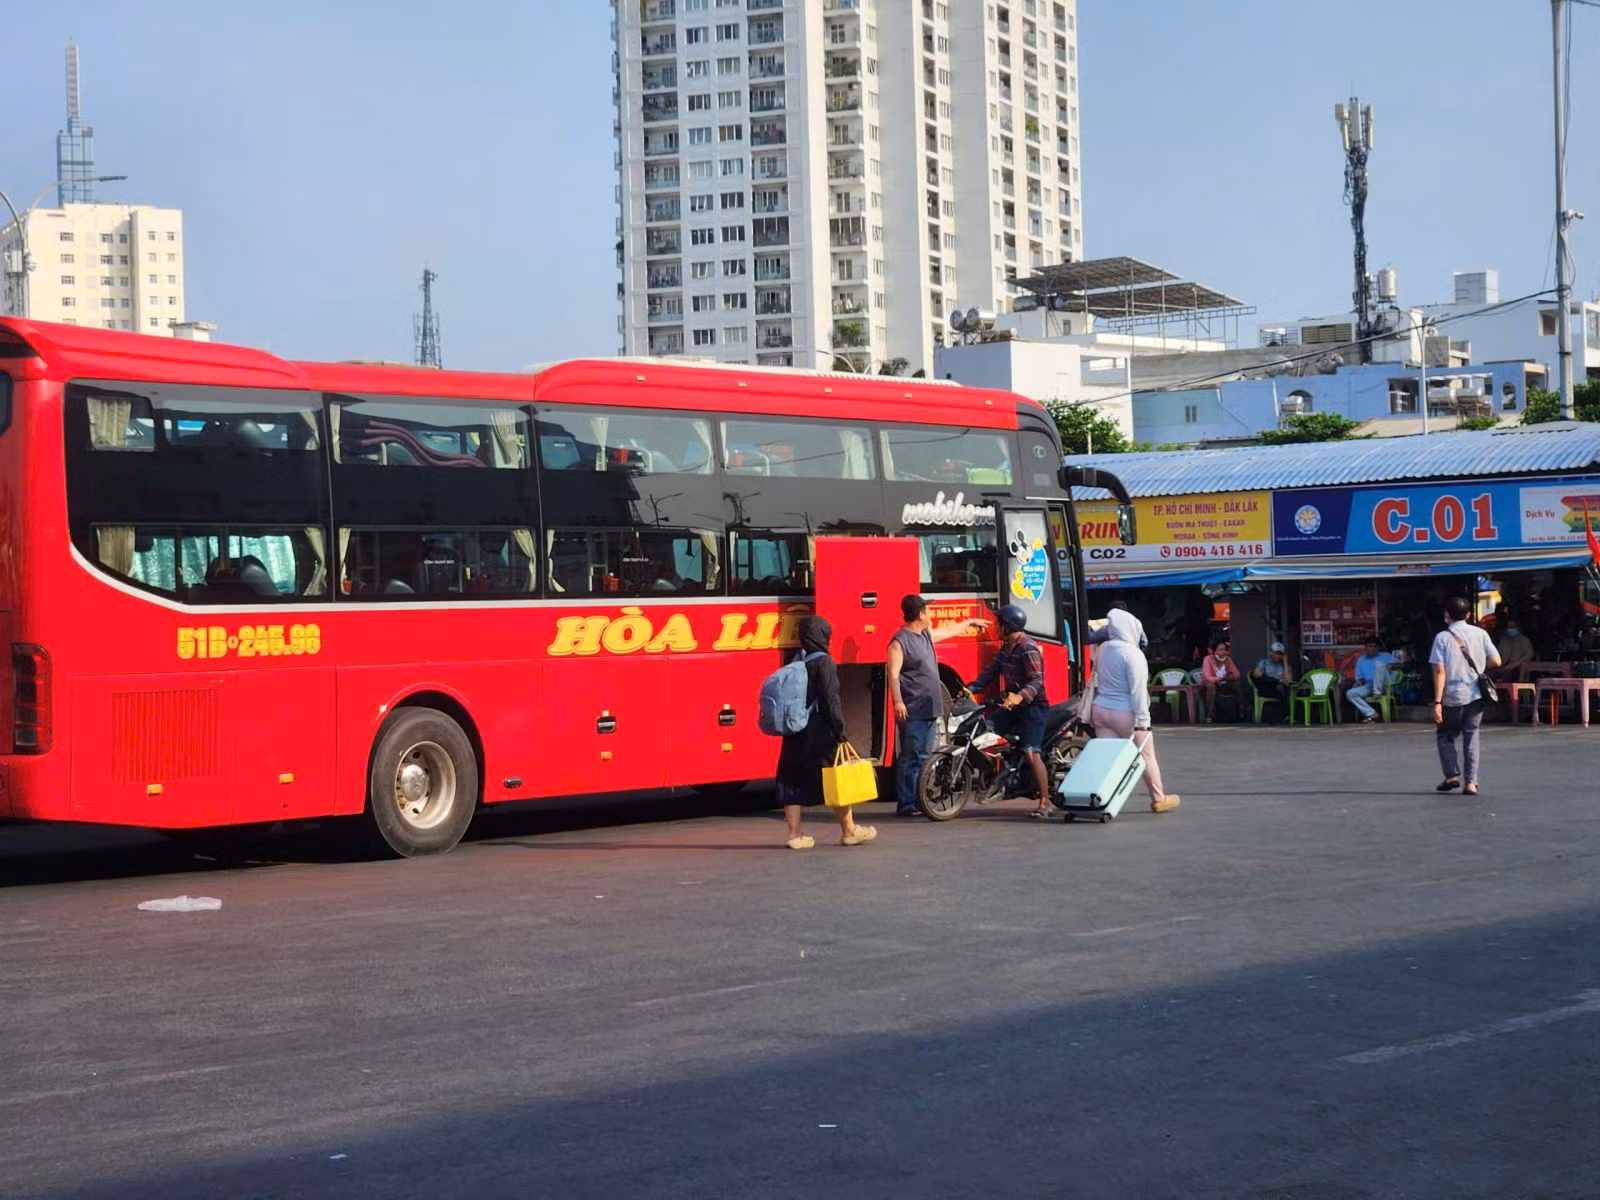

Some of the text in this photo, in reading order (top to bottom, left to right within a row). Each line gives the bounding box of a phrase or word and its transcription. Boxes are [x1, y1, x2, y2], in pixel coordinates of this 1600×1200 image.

[902, 490, 996, 527] mobihom
[1153, 504, 1164, 516] TP.
[1195, 503, 1217, 514] MINH
[1372, 493, 1498, 545] C.01
[1175, 544, 1263, 557] 0904 416 416
[547, 603, 809, 656] HÒA LIÊ
